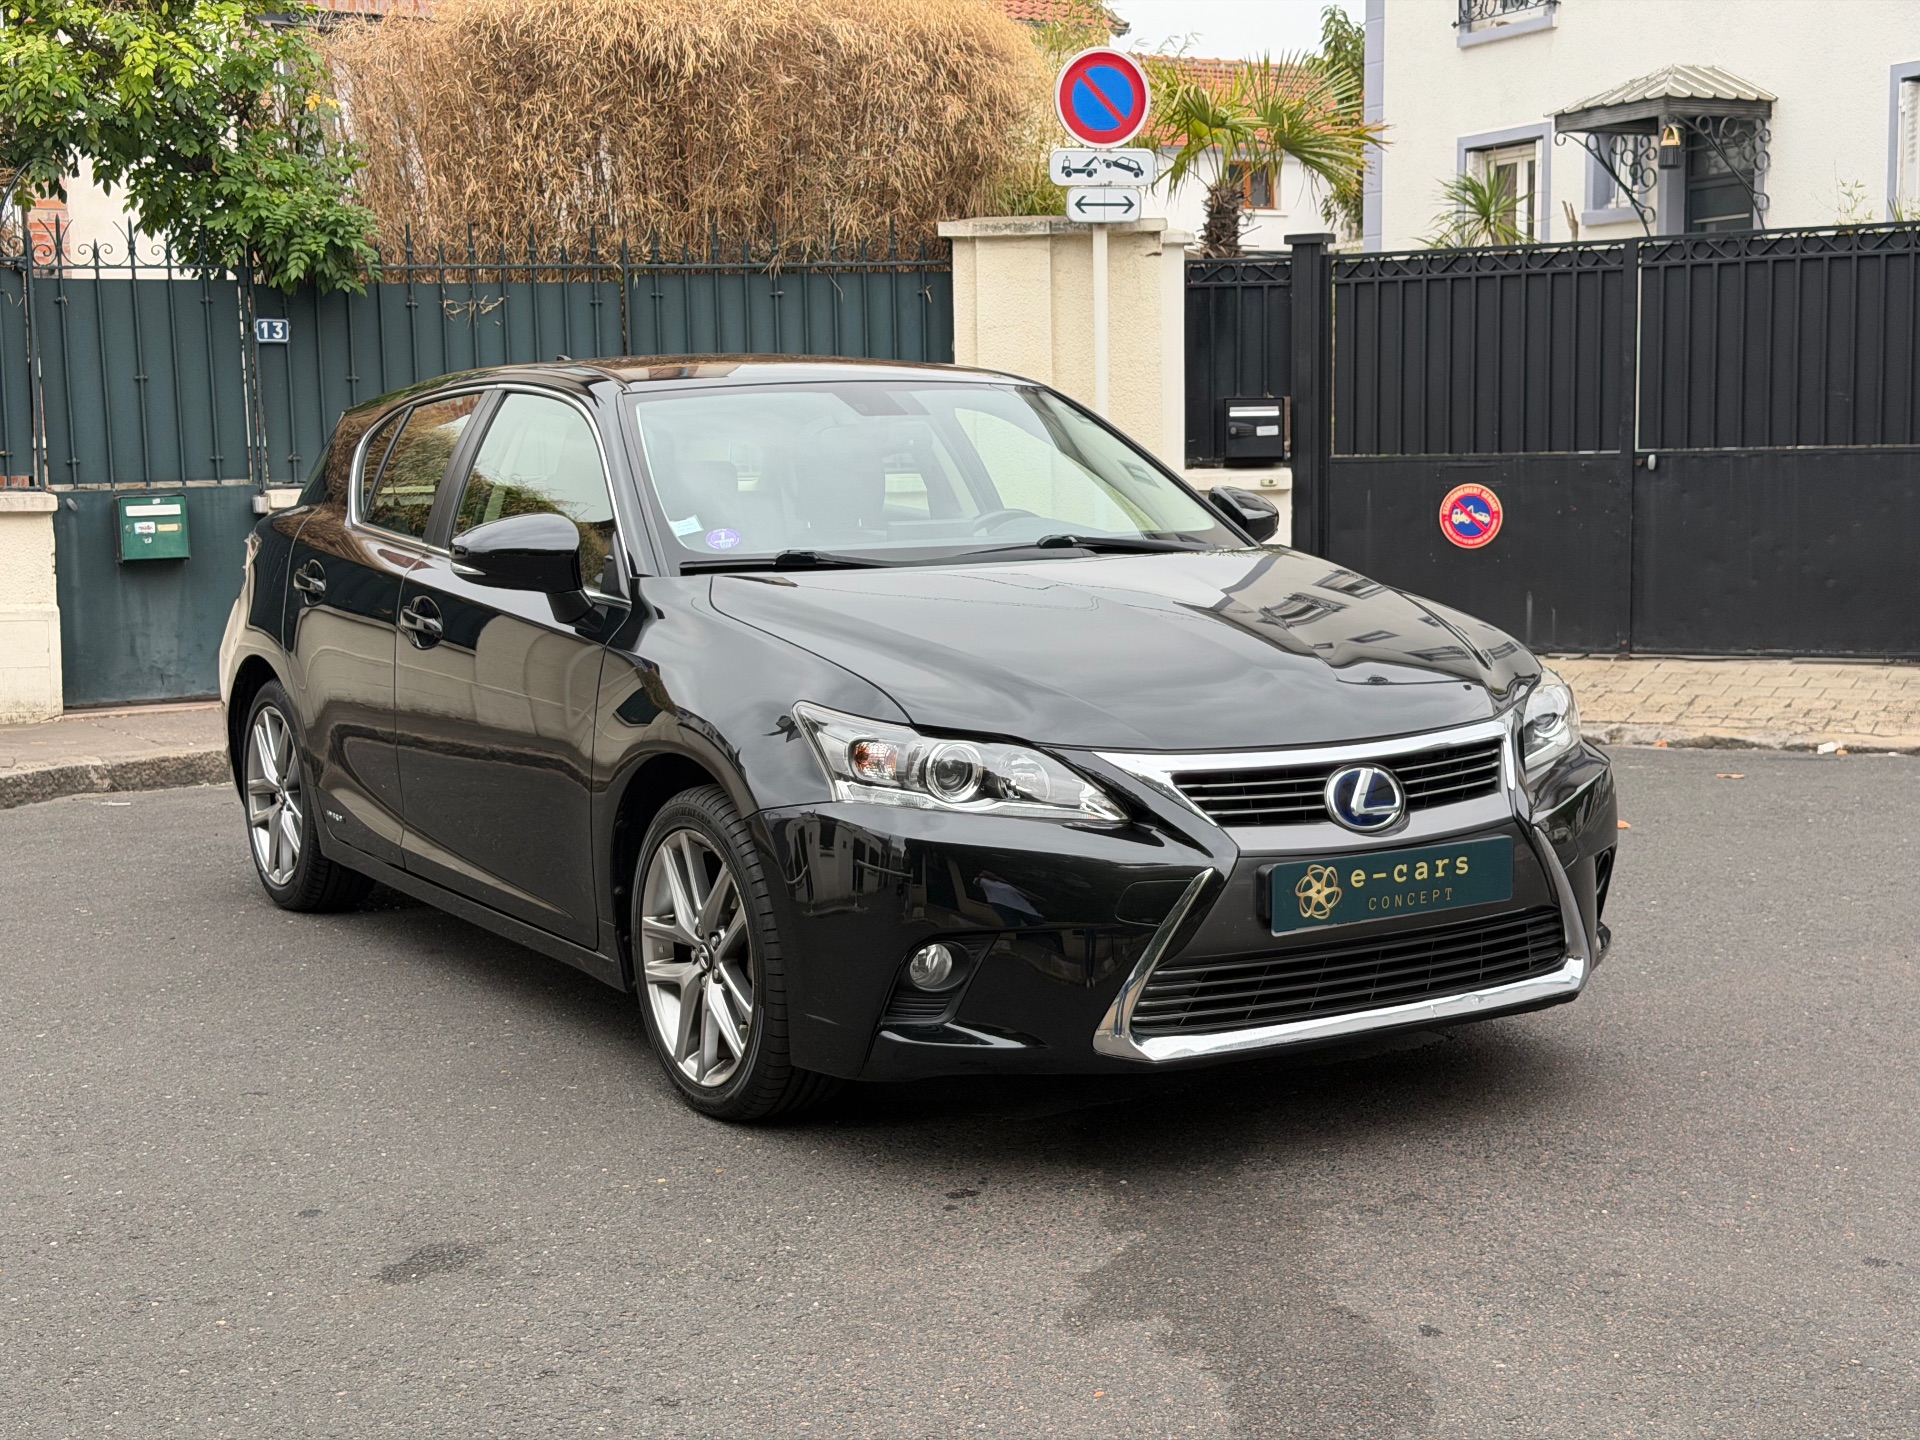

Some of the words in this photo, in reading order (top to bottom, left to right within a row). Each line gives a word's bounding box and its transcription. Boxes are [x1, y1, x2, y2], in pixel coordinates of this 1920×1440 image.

[261, 321, 283, 339] 13
[1350, 855, 1469, 888] e-cars
[1368, 887, 1453, 910] CONCEPT
